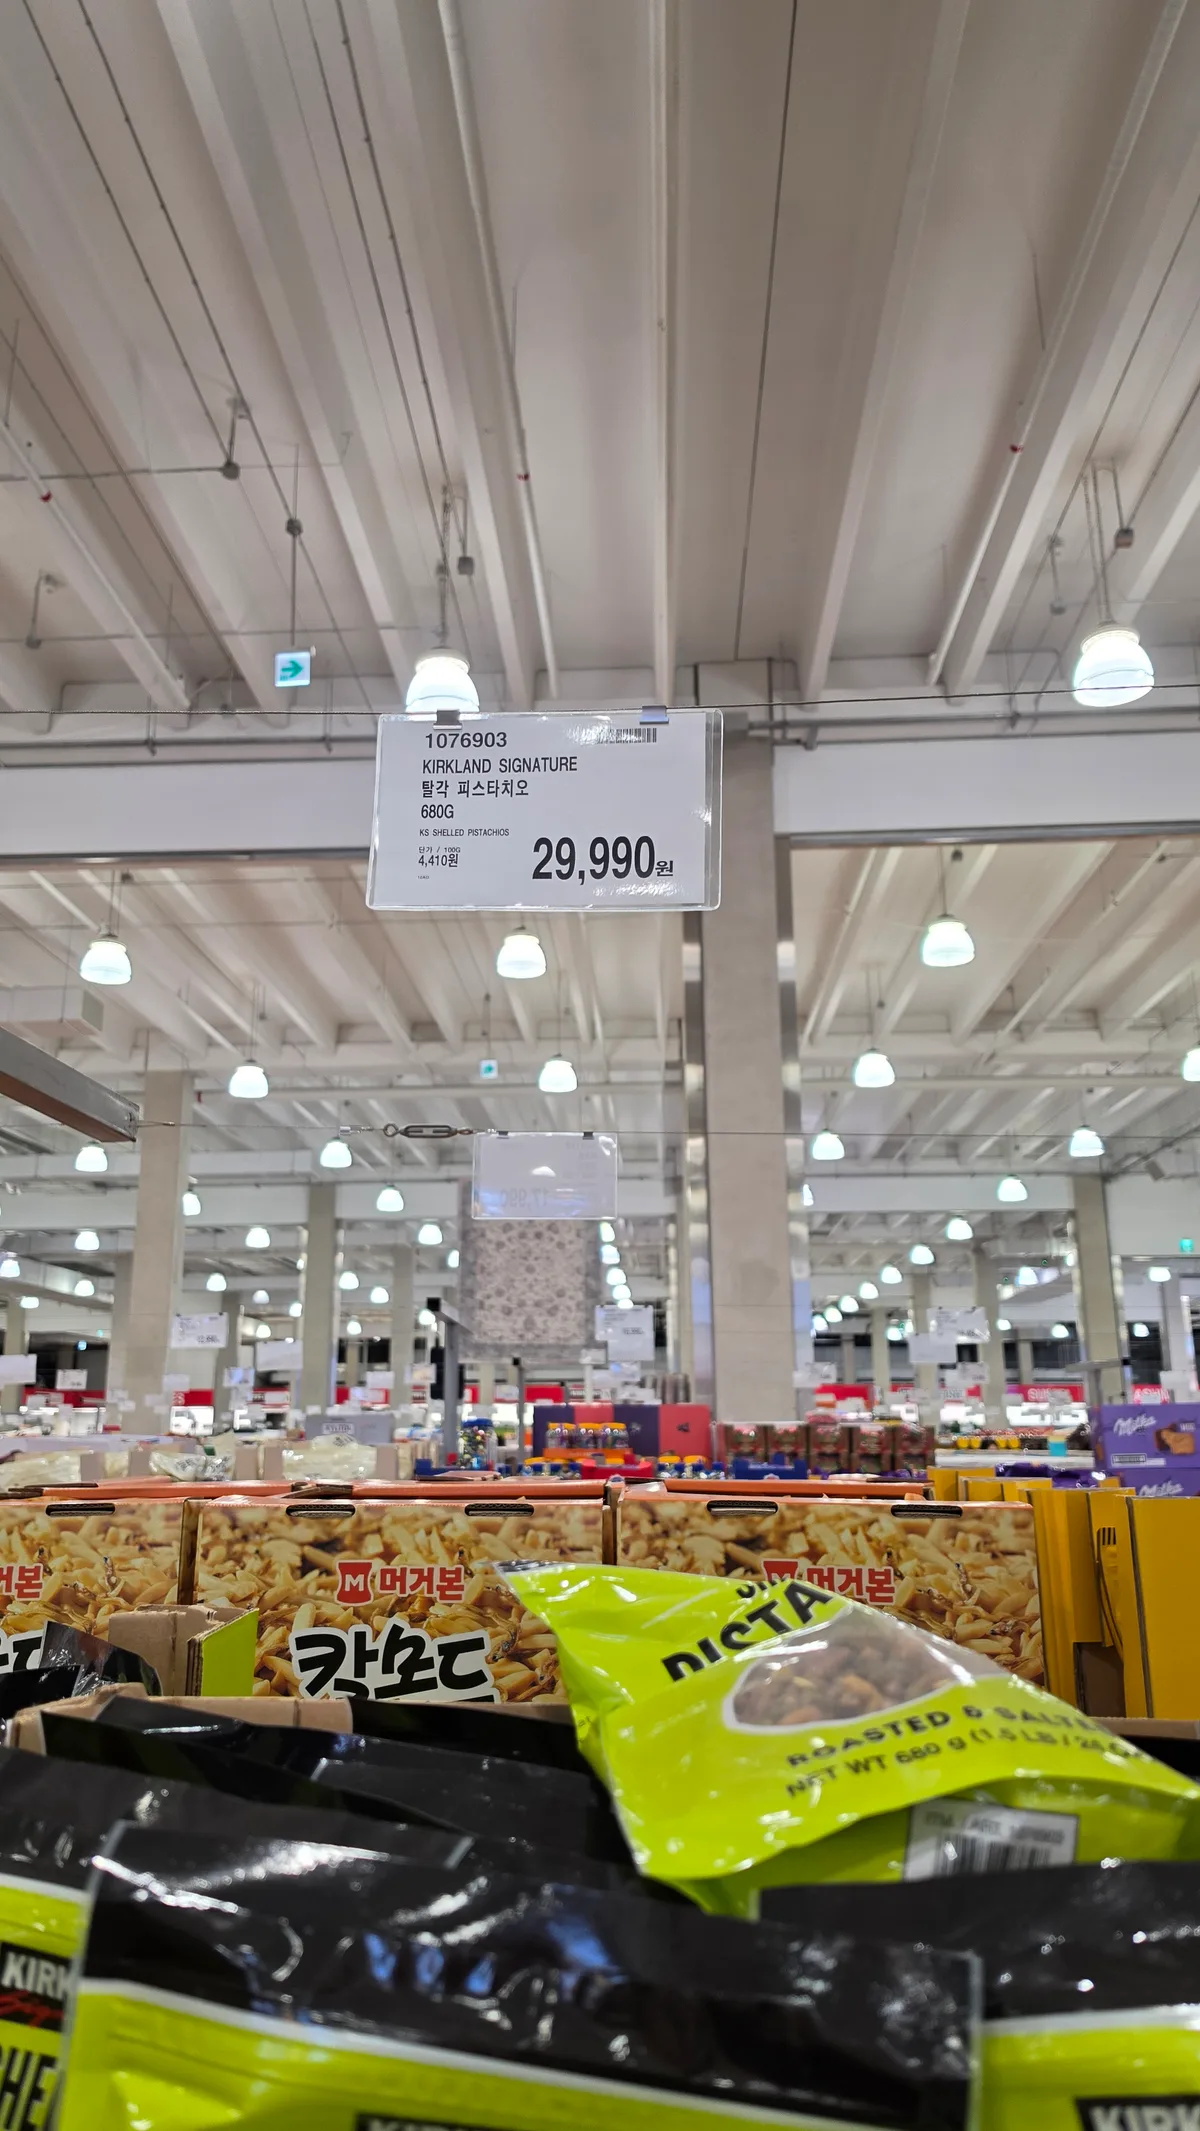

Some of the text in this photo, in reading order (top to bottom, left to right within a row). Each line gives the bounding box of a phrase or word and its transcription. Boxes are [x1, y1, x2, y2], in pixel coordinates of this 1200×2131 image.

[425, 732, 507, 748] 1076903
[422, 756, 578, 774] KIRKLAND SIGNATURE
[422, 779, 529, 798] 탈각 피스타치오
[421, 804, 454, 819] 680G
[419, 828, 510, 836] KS SHELLED PISTACHIOS
[418, 846, 433, 854] 단가
[418, 853, 459, 868] 4,410원
[532, 835, 674, 886] 29,990원
[379, 1566, 465, 1601] 머거본
[806, 1567, 895, 1603] 머거본
[786, 1711, 950, 1767] ROASTED
[845, 1754, 889, 1775] WT
[895, 1742, 941, 1764] 680
